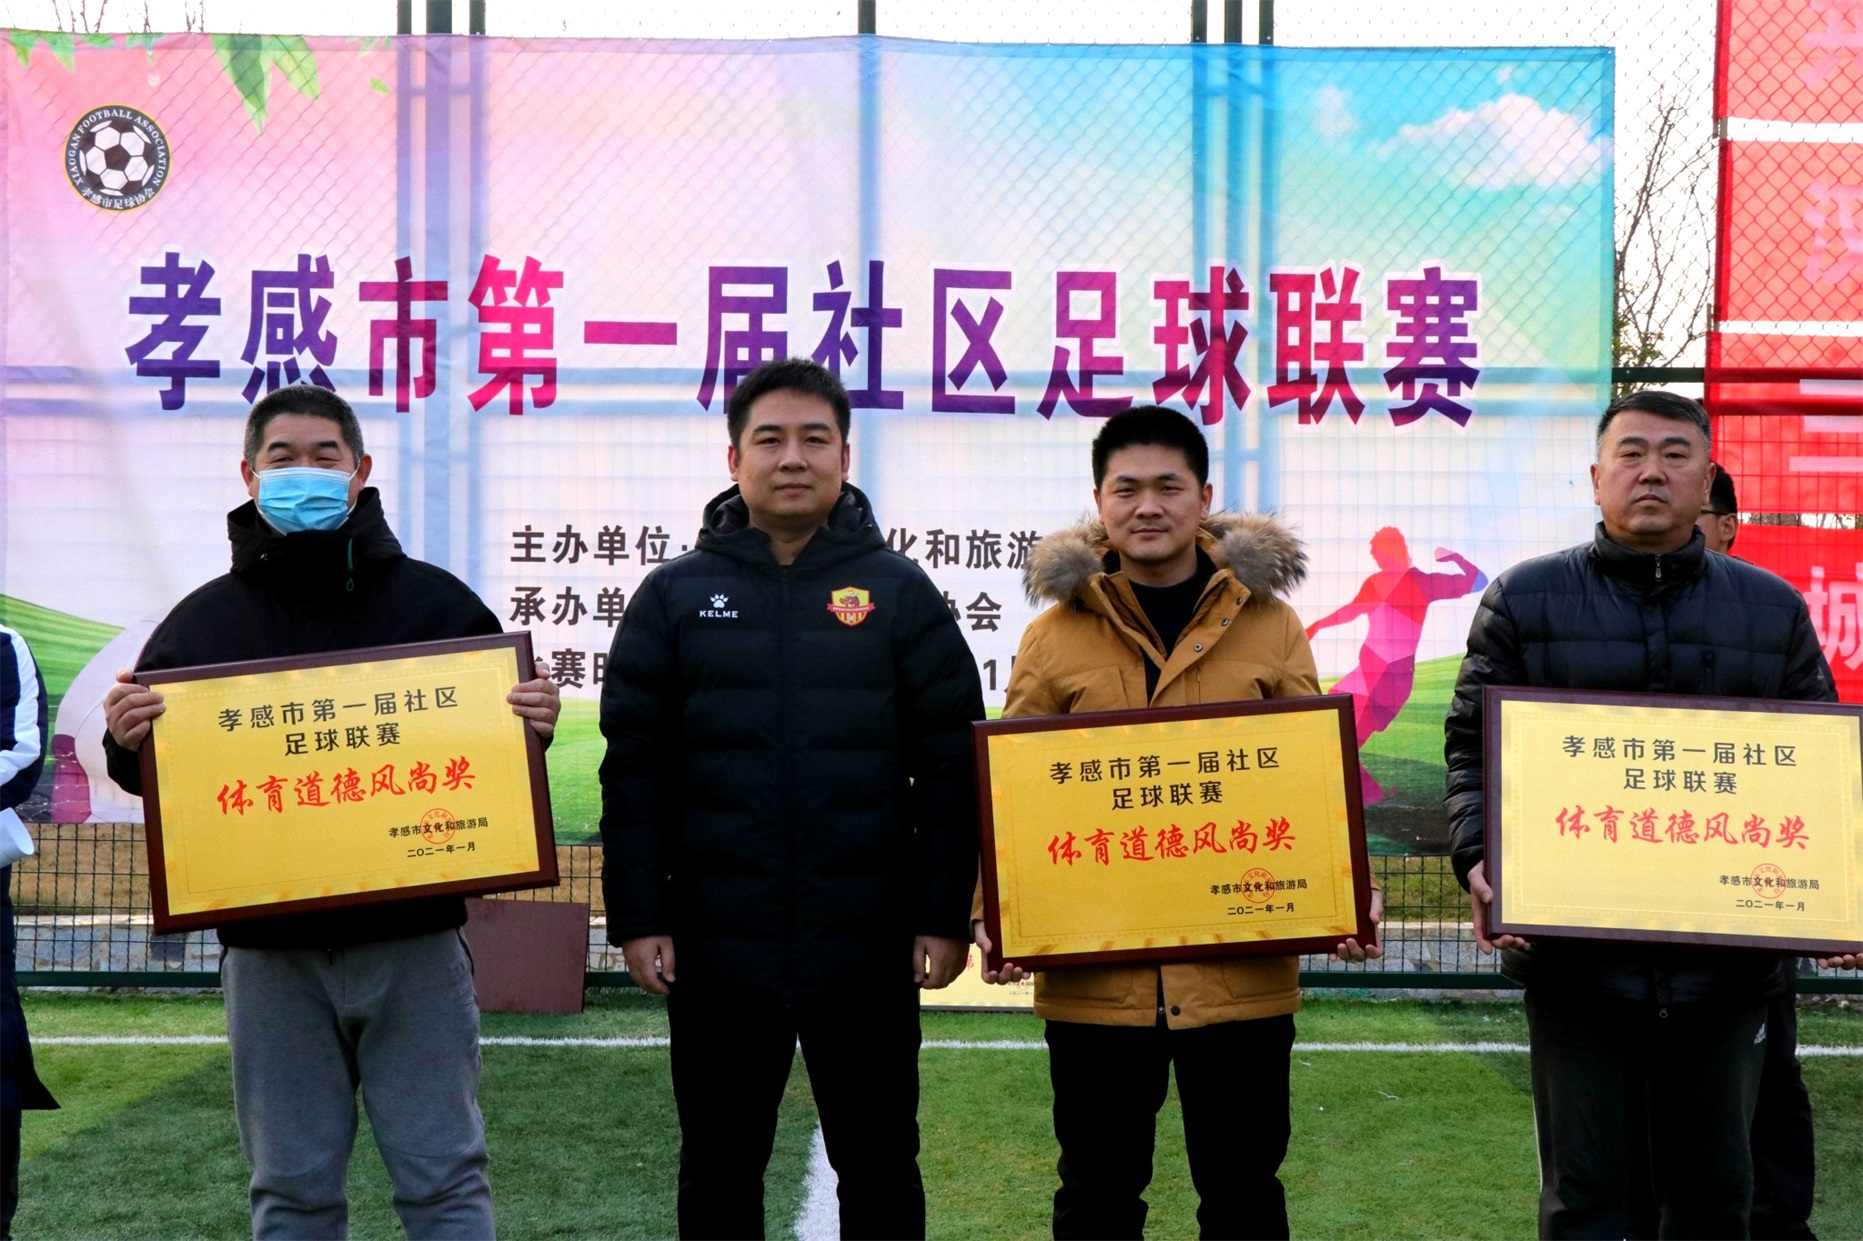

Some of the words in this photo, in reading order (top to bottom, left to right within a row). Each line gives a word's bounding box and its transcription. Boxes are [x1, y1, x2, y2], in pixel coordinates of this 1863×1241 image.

[68, 133, 85, 186] XIAOGAN
[77, 108, 133, 135] FOOTBALL
[134, 116, 167, 186] ASSOCIATION
[125, 251, 1482, 428] 孝感市第一届社区足球联赛
[699, 609, 739, 619] KELME
[217, 686, 460, 733] 孝感市第一届社区
[284, 722, 401, 757] 足球联赛
[1562, 735, 1798, 767] 孝感市第一届社区
[1049, 746, 1280, 785] 孝感市第一届社区
[1622, 768, 1738, 795] 足球联赛
[216, 755, 477, 816] 体育道德风尚奖
[1111, 781, 1224, 810] 足球联赛
[389, 817, 489, 838] 孝感市文化和旅游局
[1047, 815, 1297, 866] 体育道德风尚奖
[1555, 804, 1811, 850] 体育道德风尚奖
[1210, 878, 1308, 896] 孝感市文化和旅游局
[1719, 874, 1820, 890] 孝感市文化和旅游局
